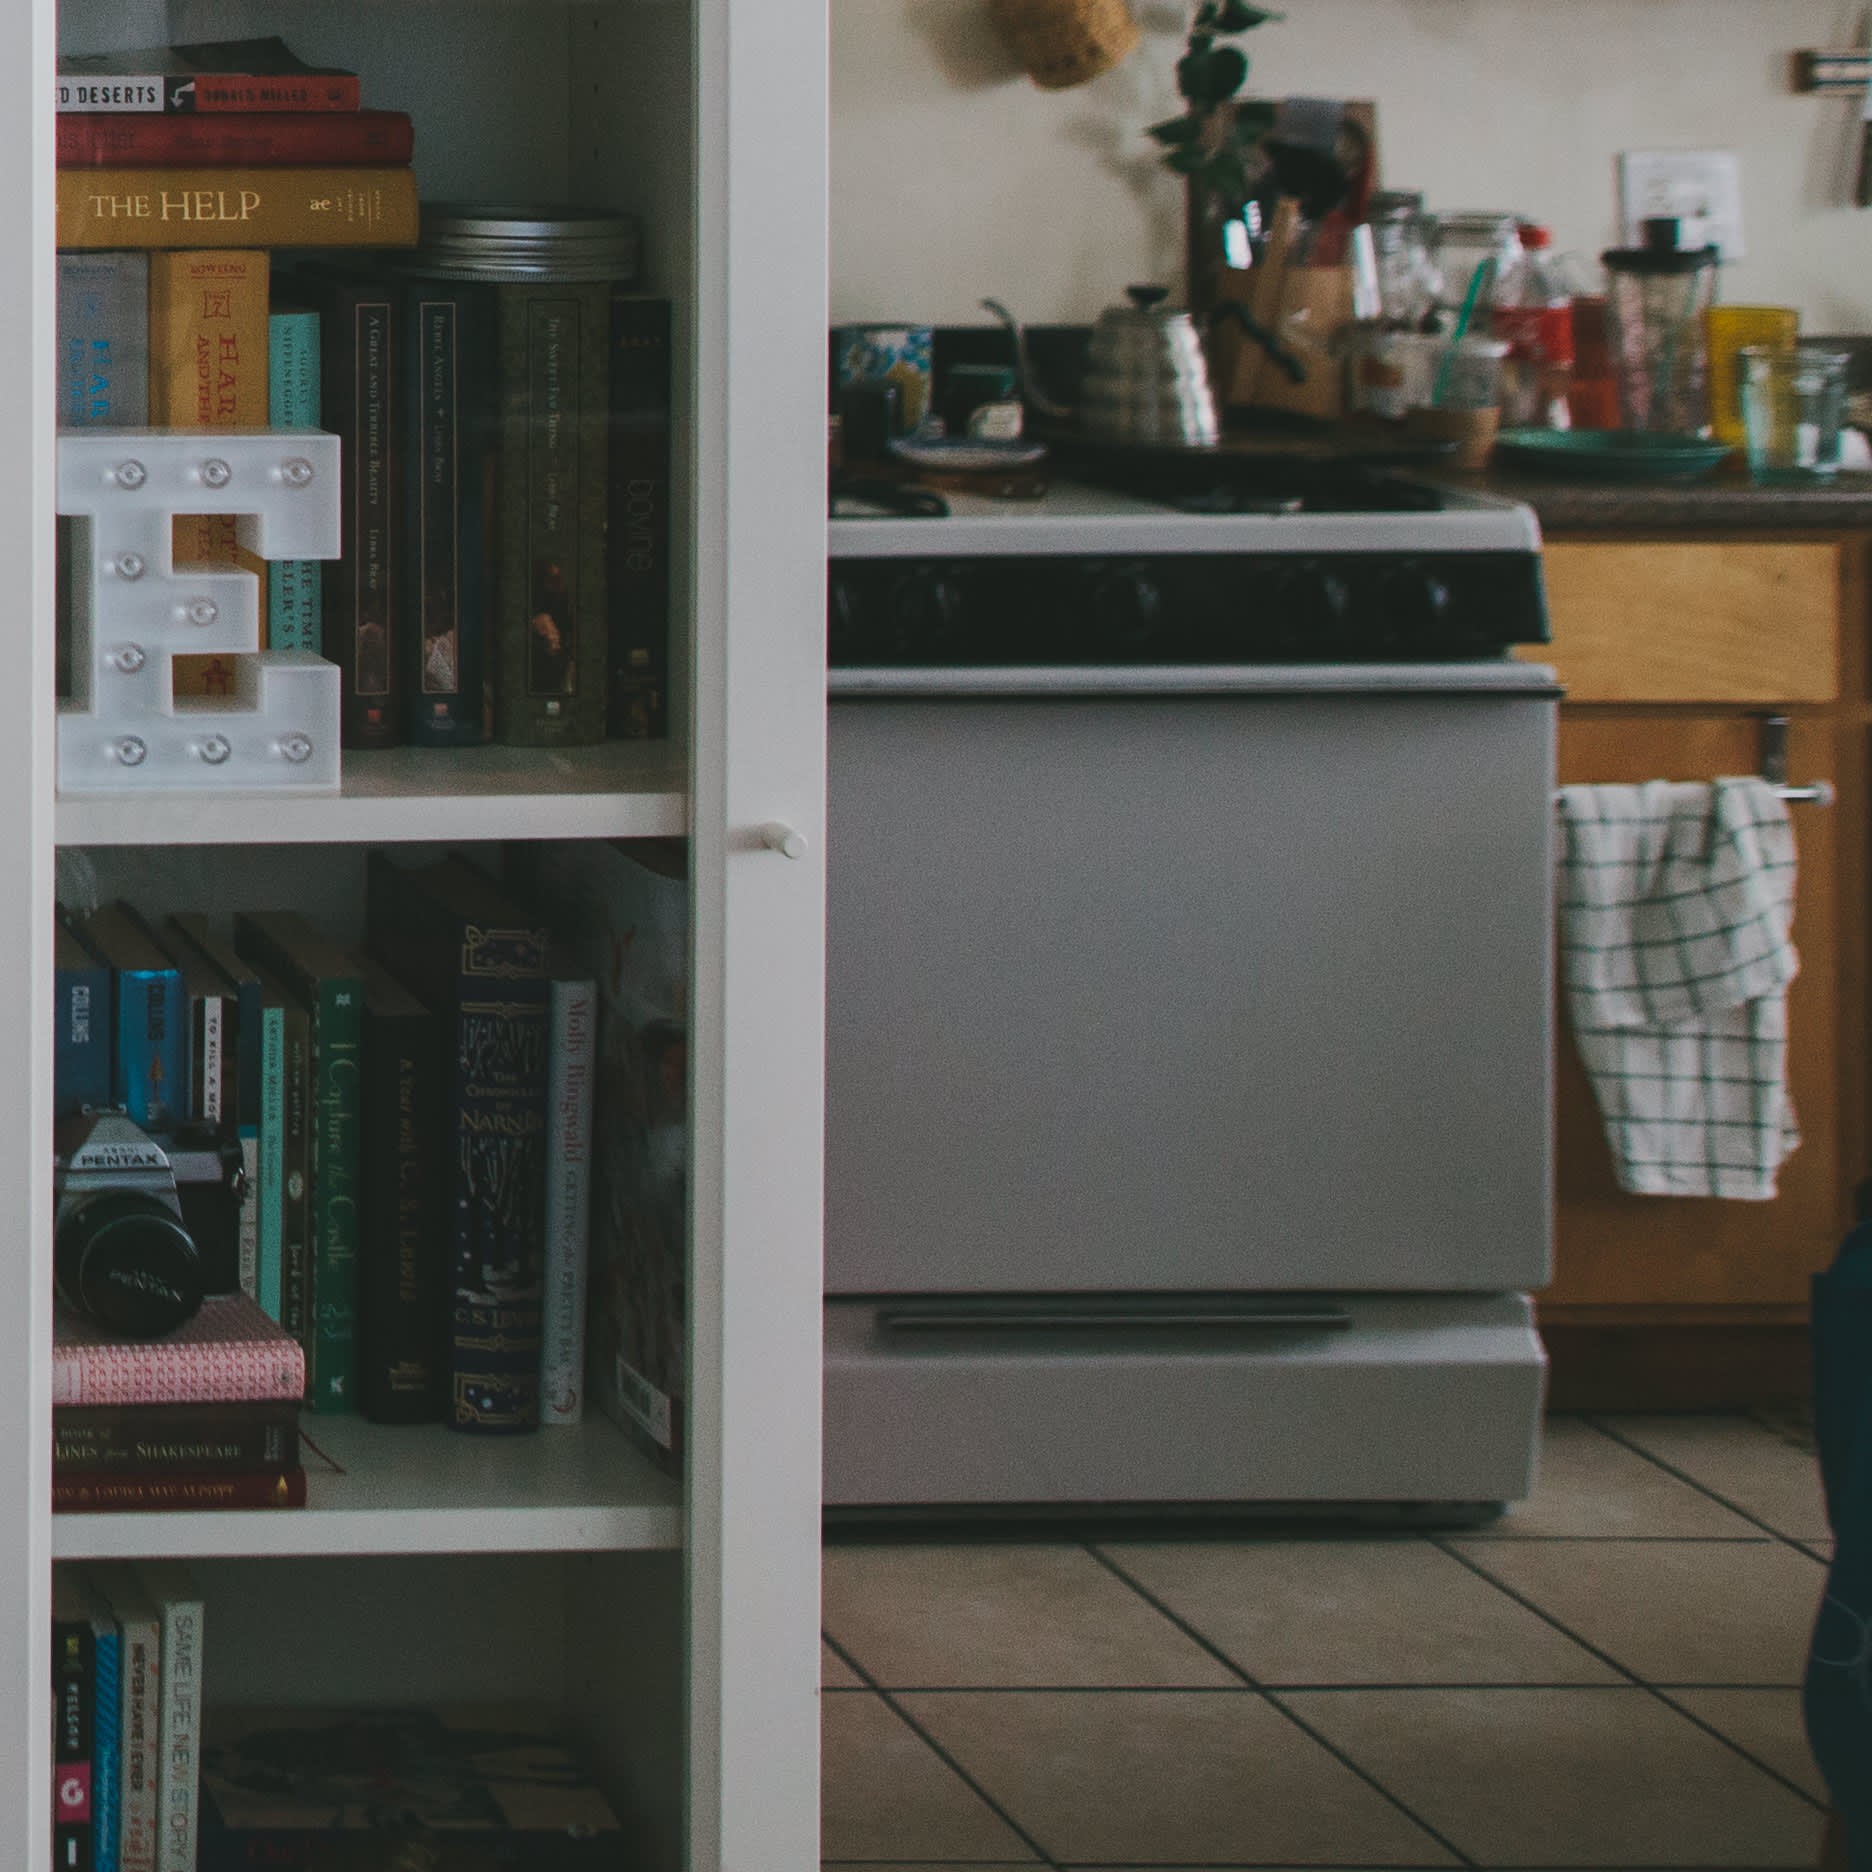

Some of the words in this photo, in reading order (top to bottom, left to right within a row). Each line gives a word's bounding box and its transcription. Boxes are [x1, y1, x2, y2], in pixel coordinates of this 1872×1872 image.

[77, 85, 157, 105] DESERTS
[89, 194, 151, 219] THE
[159, 189, 261, 221] HELP
[89, 340, 111, 419] HAR
[216, 332, 240, 420] HAR
[282, 559, 295, 633] ELER'S
[301, 560, 313, 590] HE
[56, 435, 341, 791] E
[71, 985, 91, 1044] COLLINS
[147, 983, 166, 1041] COLLINS
[566, 998, 589, 1056] Molly
[559, 1062, 587, 1164] Ringwald
[81, 1154, 159, 1166] PENTAX
[135, 1442, 241, 1460] SHAKESPEARE
[131, 1642, 145, 1697] NEVER
[174, 1614, 194, 1677] SAME
[131, 1698, 145, 1740] HAVE
[131, 1750, 145, 1791] EVER
[171, 1733, 192, 1781] NEW
[168, 1787, 191, 1861] STORY
